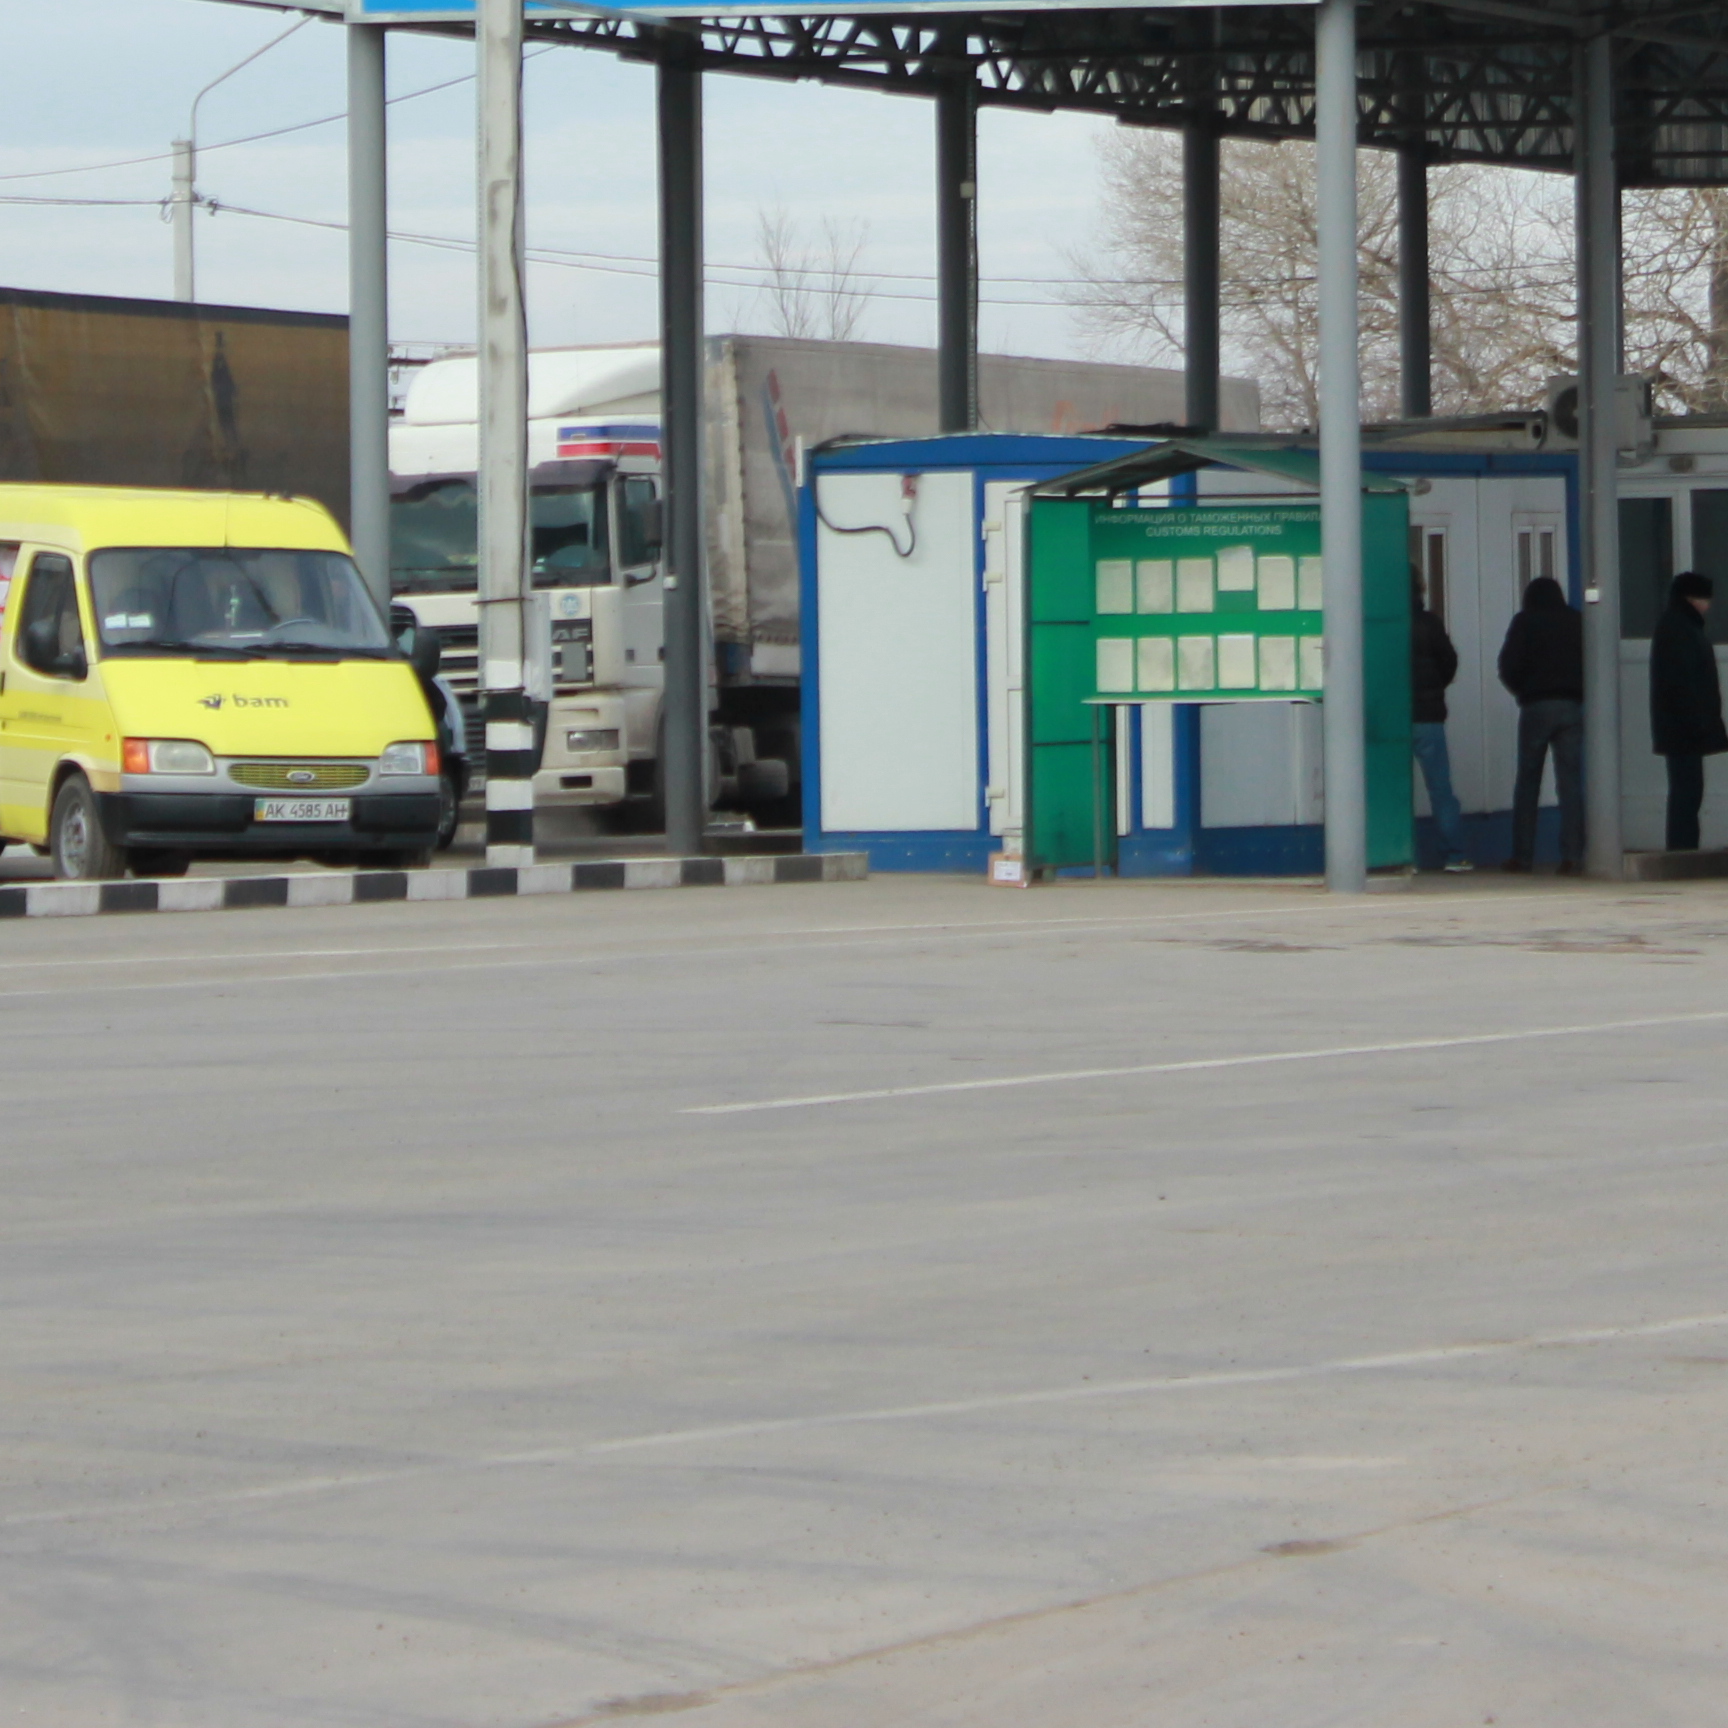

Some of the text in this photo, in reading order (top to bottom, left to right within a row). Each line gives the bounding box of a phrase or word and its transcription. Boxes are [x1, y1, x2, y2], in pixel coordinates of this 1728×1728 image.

[1095, 511, 1321, 524] ИНФОРМАЦИЯ О ТАМОЖЕННЫХ ПРАВИЛ
[1145, 525, 1282, 537] CUSTOMS REGULATIONS
[552, 628, 589, 640] AF
[232, 694, 289, 708] bam
[265, 804, 347, 817] AK 4585 AH
